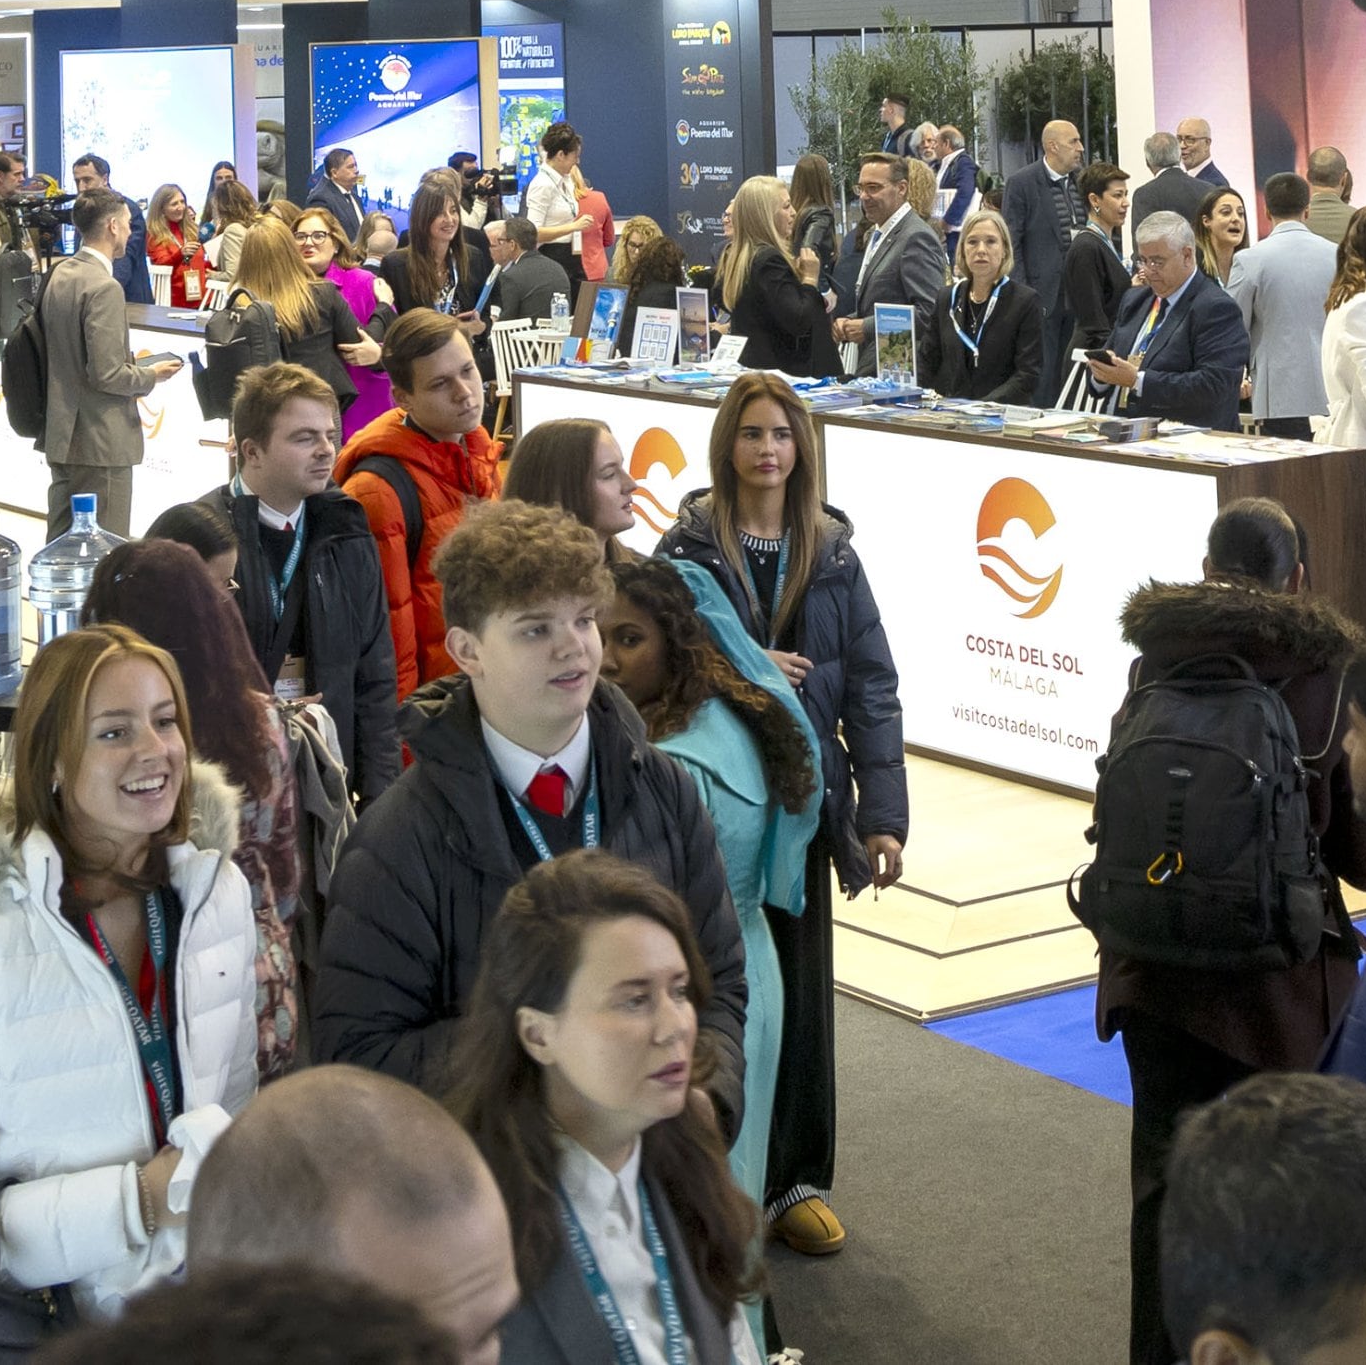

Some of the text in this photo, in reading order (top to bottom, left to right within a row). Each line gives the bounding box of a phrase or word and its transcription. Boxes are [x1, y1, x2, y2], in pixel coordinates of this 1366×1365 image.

[499, 36, 522, 59] 100%
[690, 128, 711, 138] Poema
[965, 634, 1085, 677] COSTA DEL SOL
[989, 666, 1059, 699] MÁLAGA
[951, 703, 1099, 754] visitcostadelsol.com
